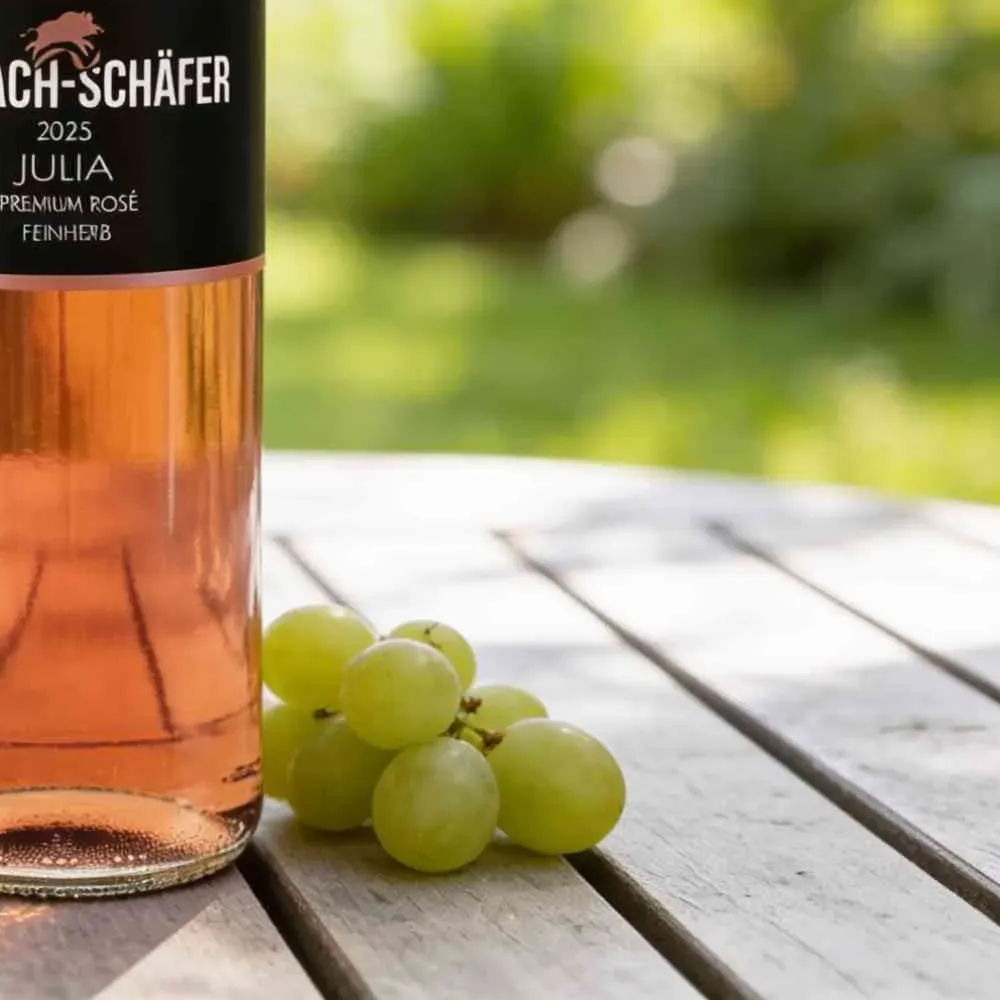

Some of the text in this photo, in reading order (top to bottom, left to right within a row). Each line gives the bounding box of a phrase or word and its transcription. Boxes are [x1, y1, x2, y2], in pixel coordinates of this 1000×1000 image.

[36, 120, 93, 142] 2025
[12, 152, 114, 187] JULIA
[0, 189, 140, 213] PREMIUM ROSÉ
